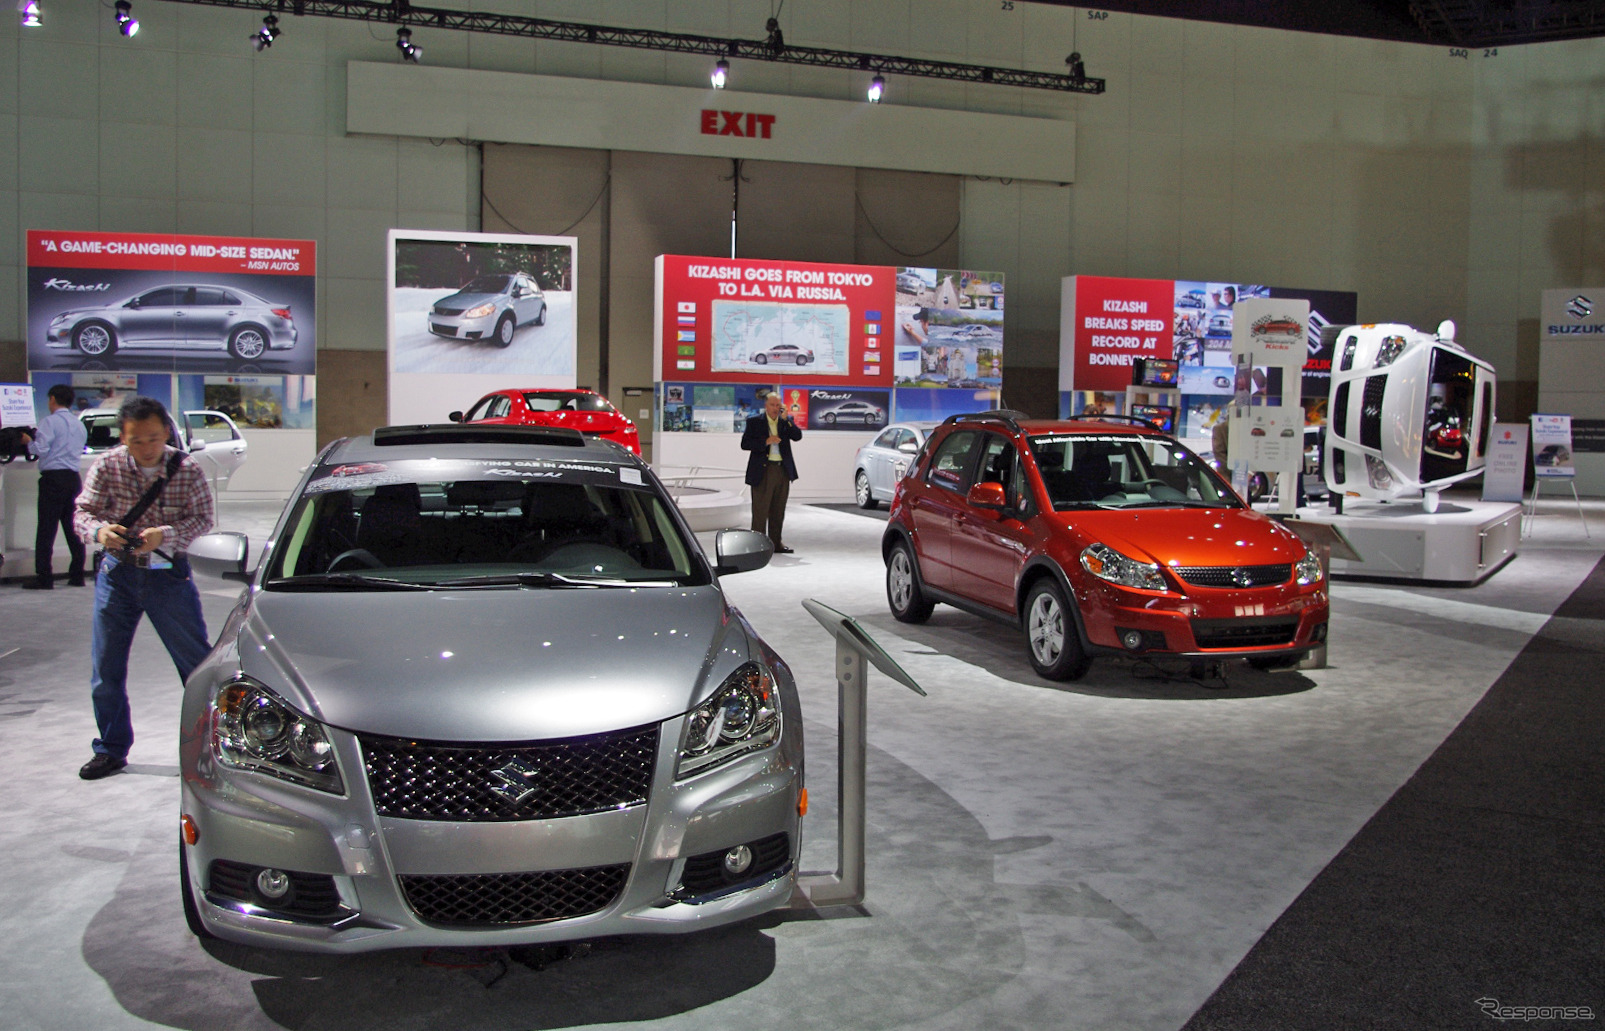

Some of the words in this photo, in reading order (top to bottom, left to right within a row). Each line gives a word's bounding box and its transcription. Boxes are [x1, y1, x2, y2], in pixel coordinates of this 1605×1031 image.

[1001, 1, 1014, 11] 25
[1087, 10, 1109, 20] SAP
[1483, 48, 1498, 58] 24
[701, 109, 776, 139] EXIT
[60, 240, 186, 256] GAME-CHANGING
[190, 244, 247, 258] MID-SIZE
[248, 261, 269, 270] MSN
[270, 261, 300, 271] AUTOS
[688, 264, 741, 280] KIZASHI
[744, 267, 783, 282] GOES
[786, 269, 824, 284] FROM
[827, 272, 873, 287] TOKYO
[718, 282, 737, 296] TO
[740, 284, 765, 297] L.A.
[769, 285, 793, 299] VIA
[796, 286, 847, 300] RUSSIA.
[1103, 299, 1148, 313] KIZASHI
[1084, 316, 1128, 331] BREAKS
[1130, 319, 1165, 332] SPEED
[1548, 325, 1605, 335] SUZUK
[1092, 335, 1140, 349] RECORD
[1142, 337, 1157, 350] AT
[1089, 353, 1156, 366] BONNEV
[558, 463, 615, 474] AMERICA.
